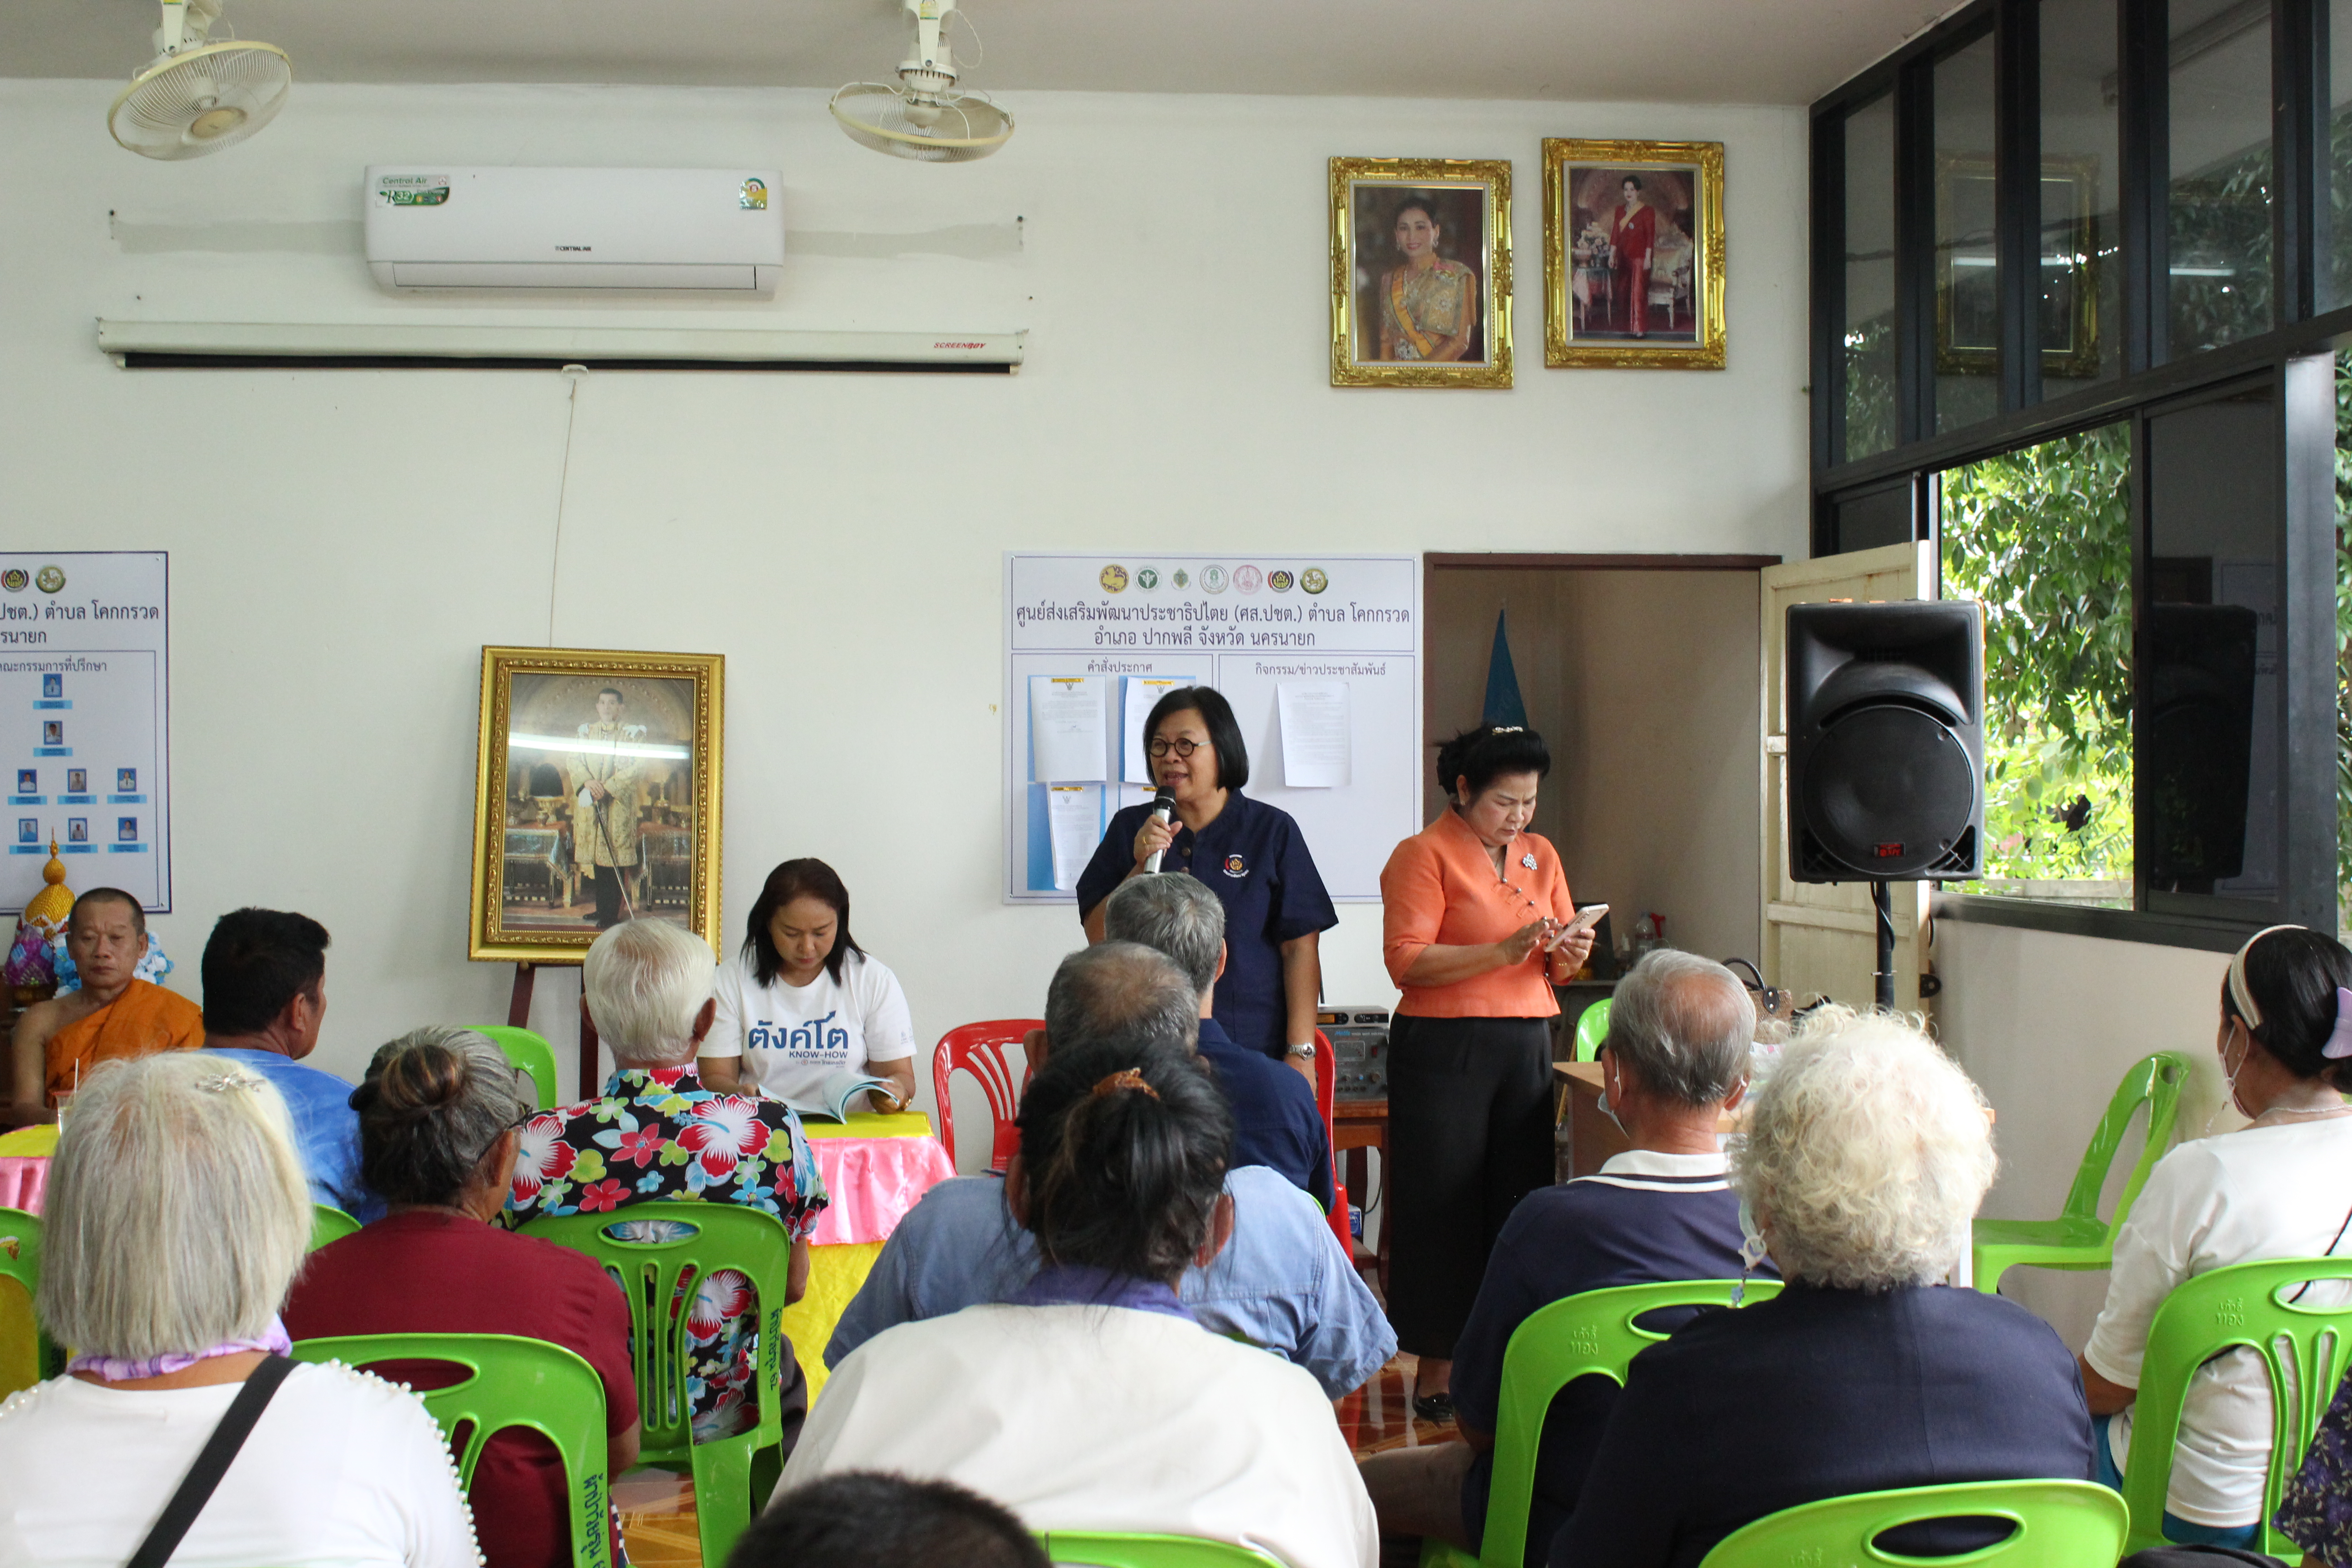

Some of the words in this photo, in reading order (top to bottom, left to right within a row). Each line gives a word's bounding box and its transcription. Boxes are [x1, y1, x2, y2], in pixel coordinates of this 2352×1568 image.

[46, 600, 86, 619] ตำบล
[91, 600, 158, 620] โคกกรวด
[1017, 599, 1228, 627] ศูนย์ส่งเสริมพัฒนาประชาธิปไตย
[1234, 604, 1303, 623] (ศส.ปชต.)
[1308, 603, 1345, 622] ตำบล
[1350, 602, 1410, 622] โคกกรวด
[1095, 625, 1137, 645] อำเภอ
[1142, 625, 1192, 645] ปากพลี
[1199, 626, 1244, 646] จังหวัด
[1251, 632, 1315, 646] นครนายก
[1088, 657, 1152, 673] คำสั่งประกาศ
[1255, 662, 1386, 676] กิจกรรม/ข่าวประชาสัมพันธ์
[749, 1010, 848, 1049] ตังค์โต
